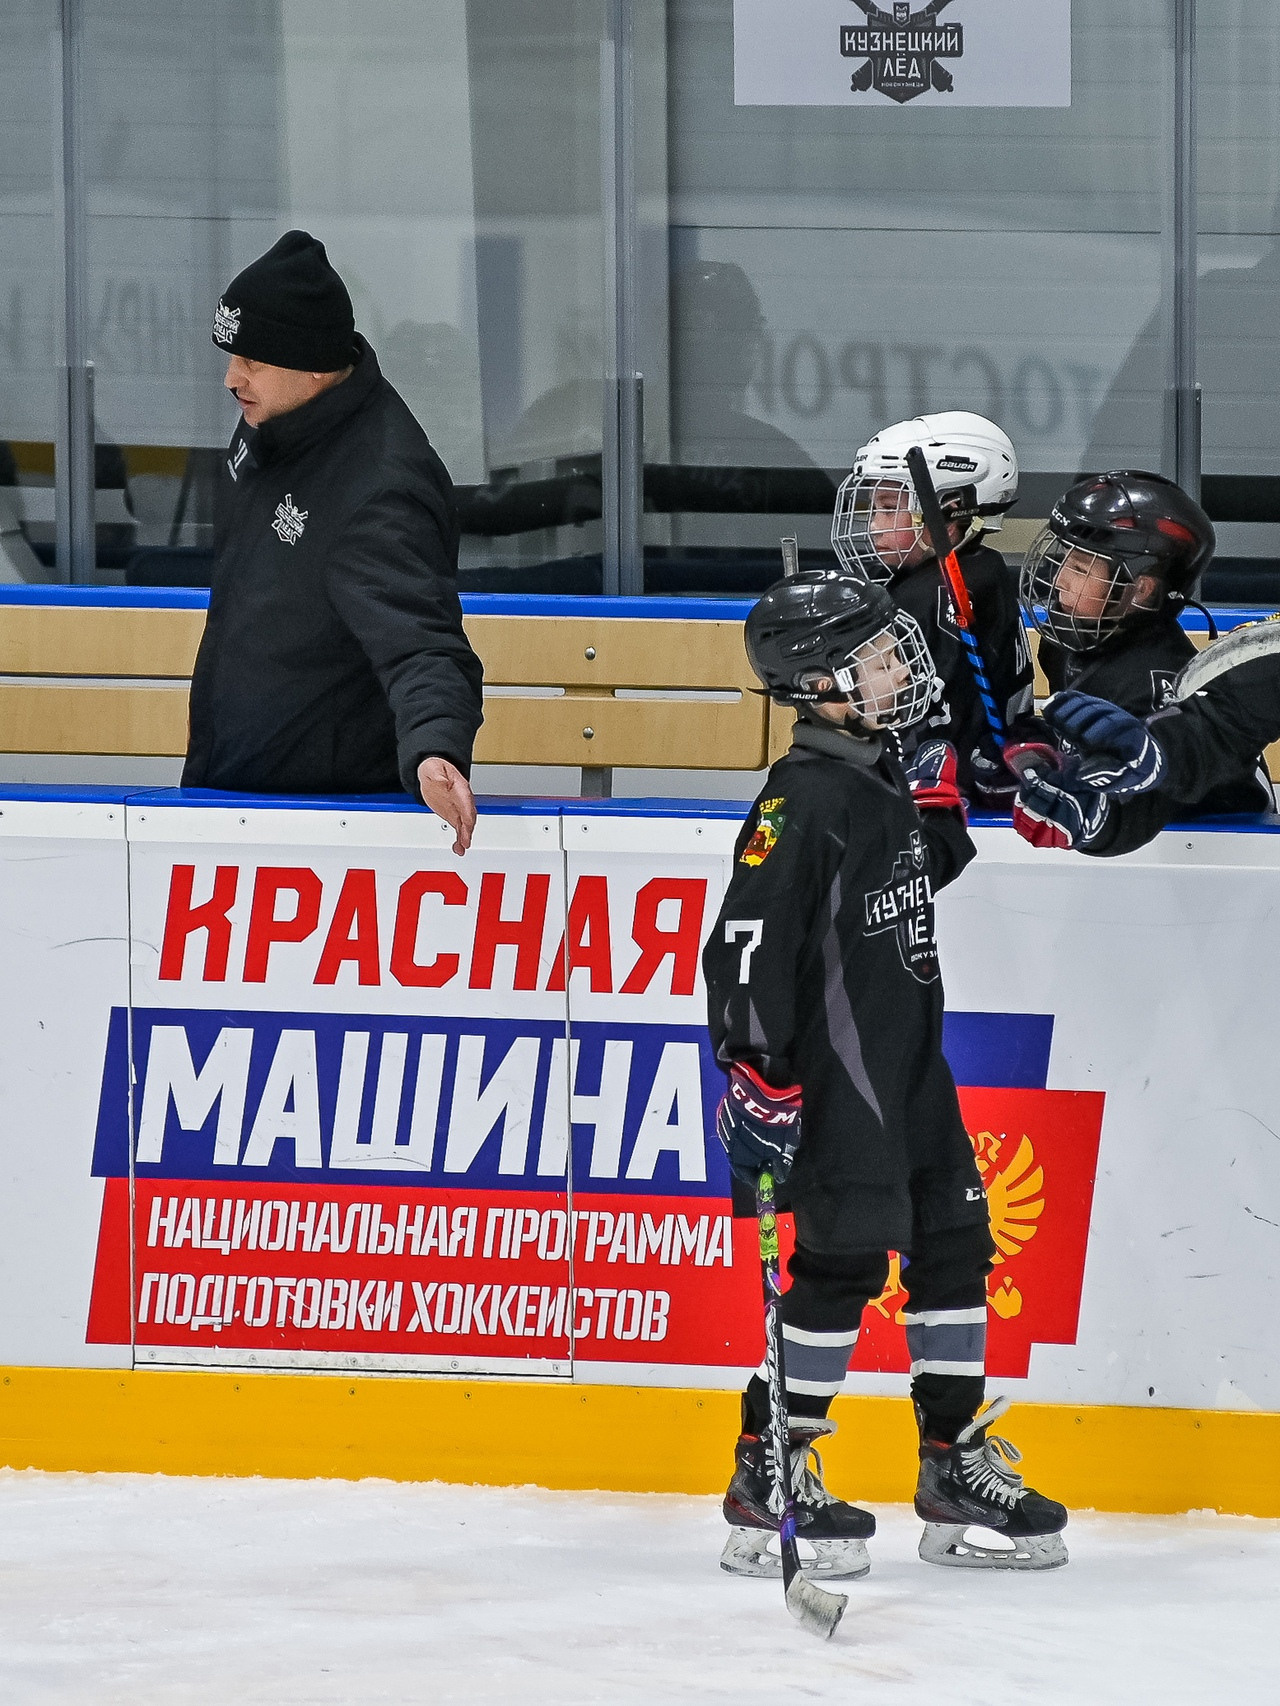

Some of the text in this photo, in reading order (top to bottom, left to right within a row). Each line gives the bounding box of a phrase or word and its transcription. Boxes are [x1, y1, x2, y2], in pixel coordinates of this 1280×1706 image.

[845, 26, 959, 52] КУЗНЕЦКИЙ
[883, 52, 921, 79] ЛЁД
[939, 460, 976, 471] BAUER
[1051, 508, 1071, 527] CCM
[158, 864, 708, 996] КРАСНАЯ
[907, 907, 937, 948] ЛЁ
[724, 918, 764, 985] 7
[136, 1025, 708, 1182] МАШИНА
[731, 1081, 797, 1125] CCM
[146, 1196, 734, 1268] НАЦИОНАЛЬНАЯ ПРОГРАММА
[136, 1272, 672, 1343] ПОДГОТОВКИ ХОККЕИСТОВ
